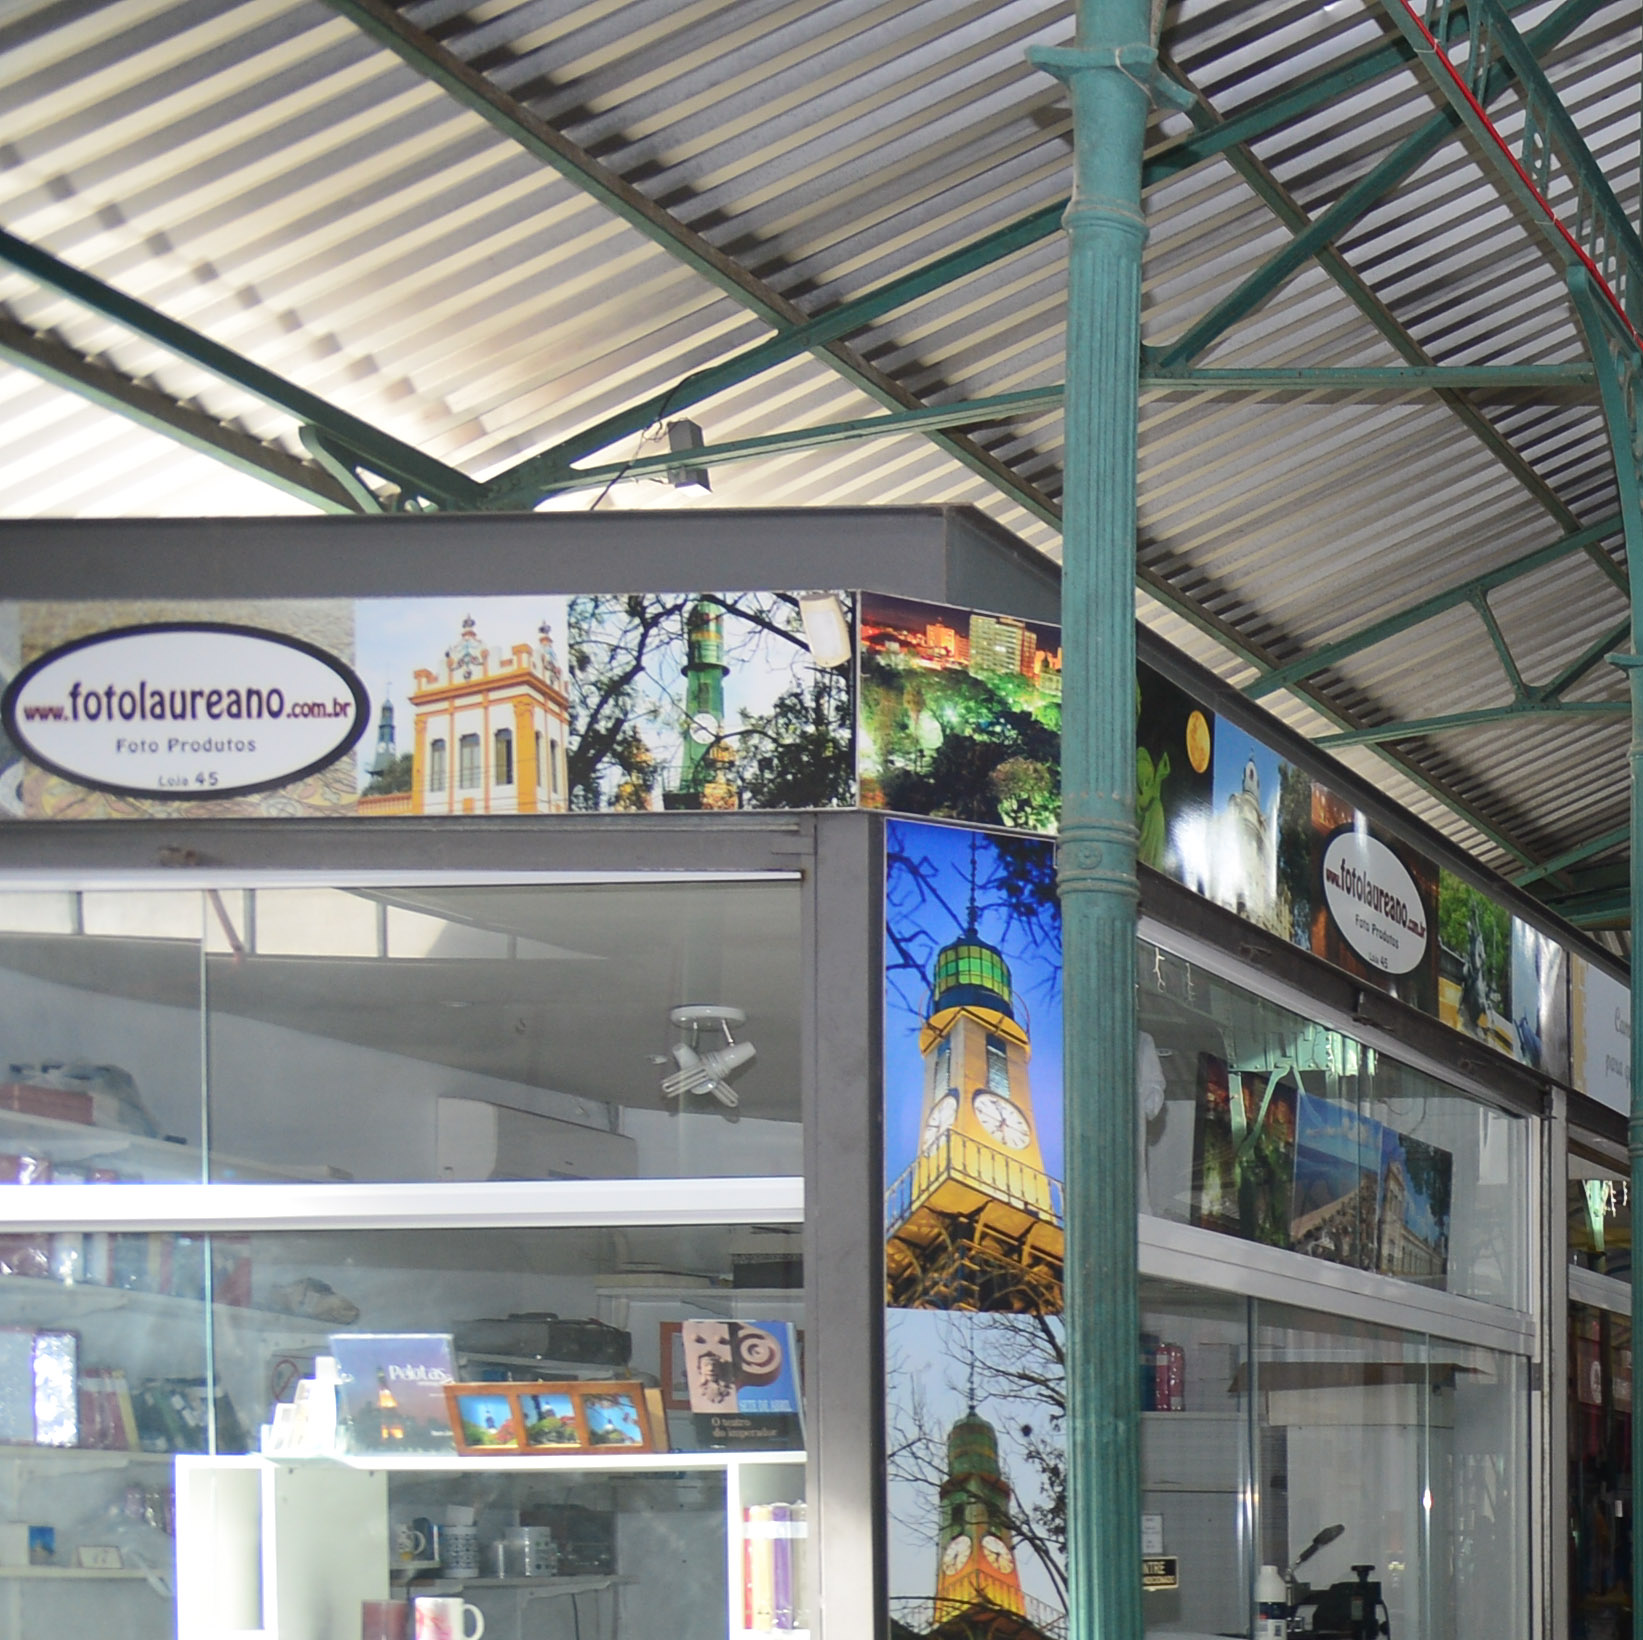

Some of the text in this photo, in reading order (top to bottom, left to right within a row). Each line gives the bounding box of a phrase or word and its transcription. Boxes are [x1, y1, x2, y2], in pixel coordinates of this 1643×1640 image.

[24, 680, 351, 722] www.fotolaureano.com.br
[115, 737, 257, 753] Foto Produtos
[195, 772, 219, 786] 45
